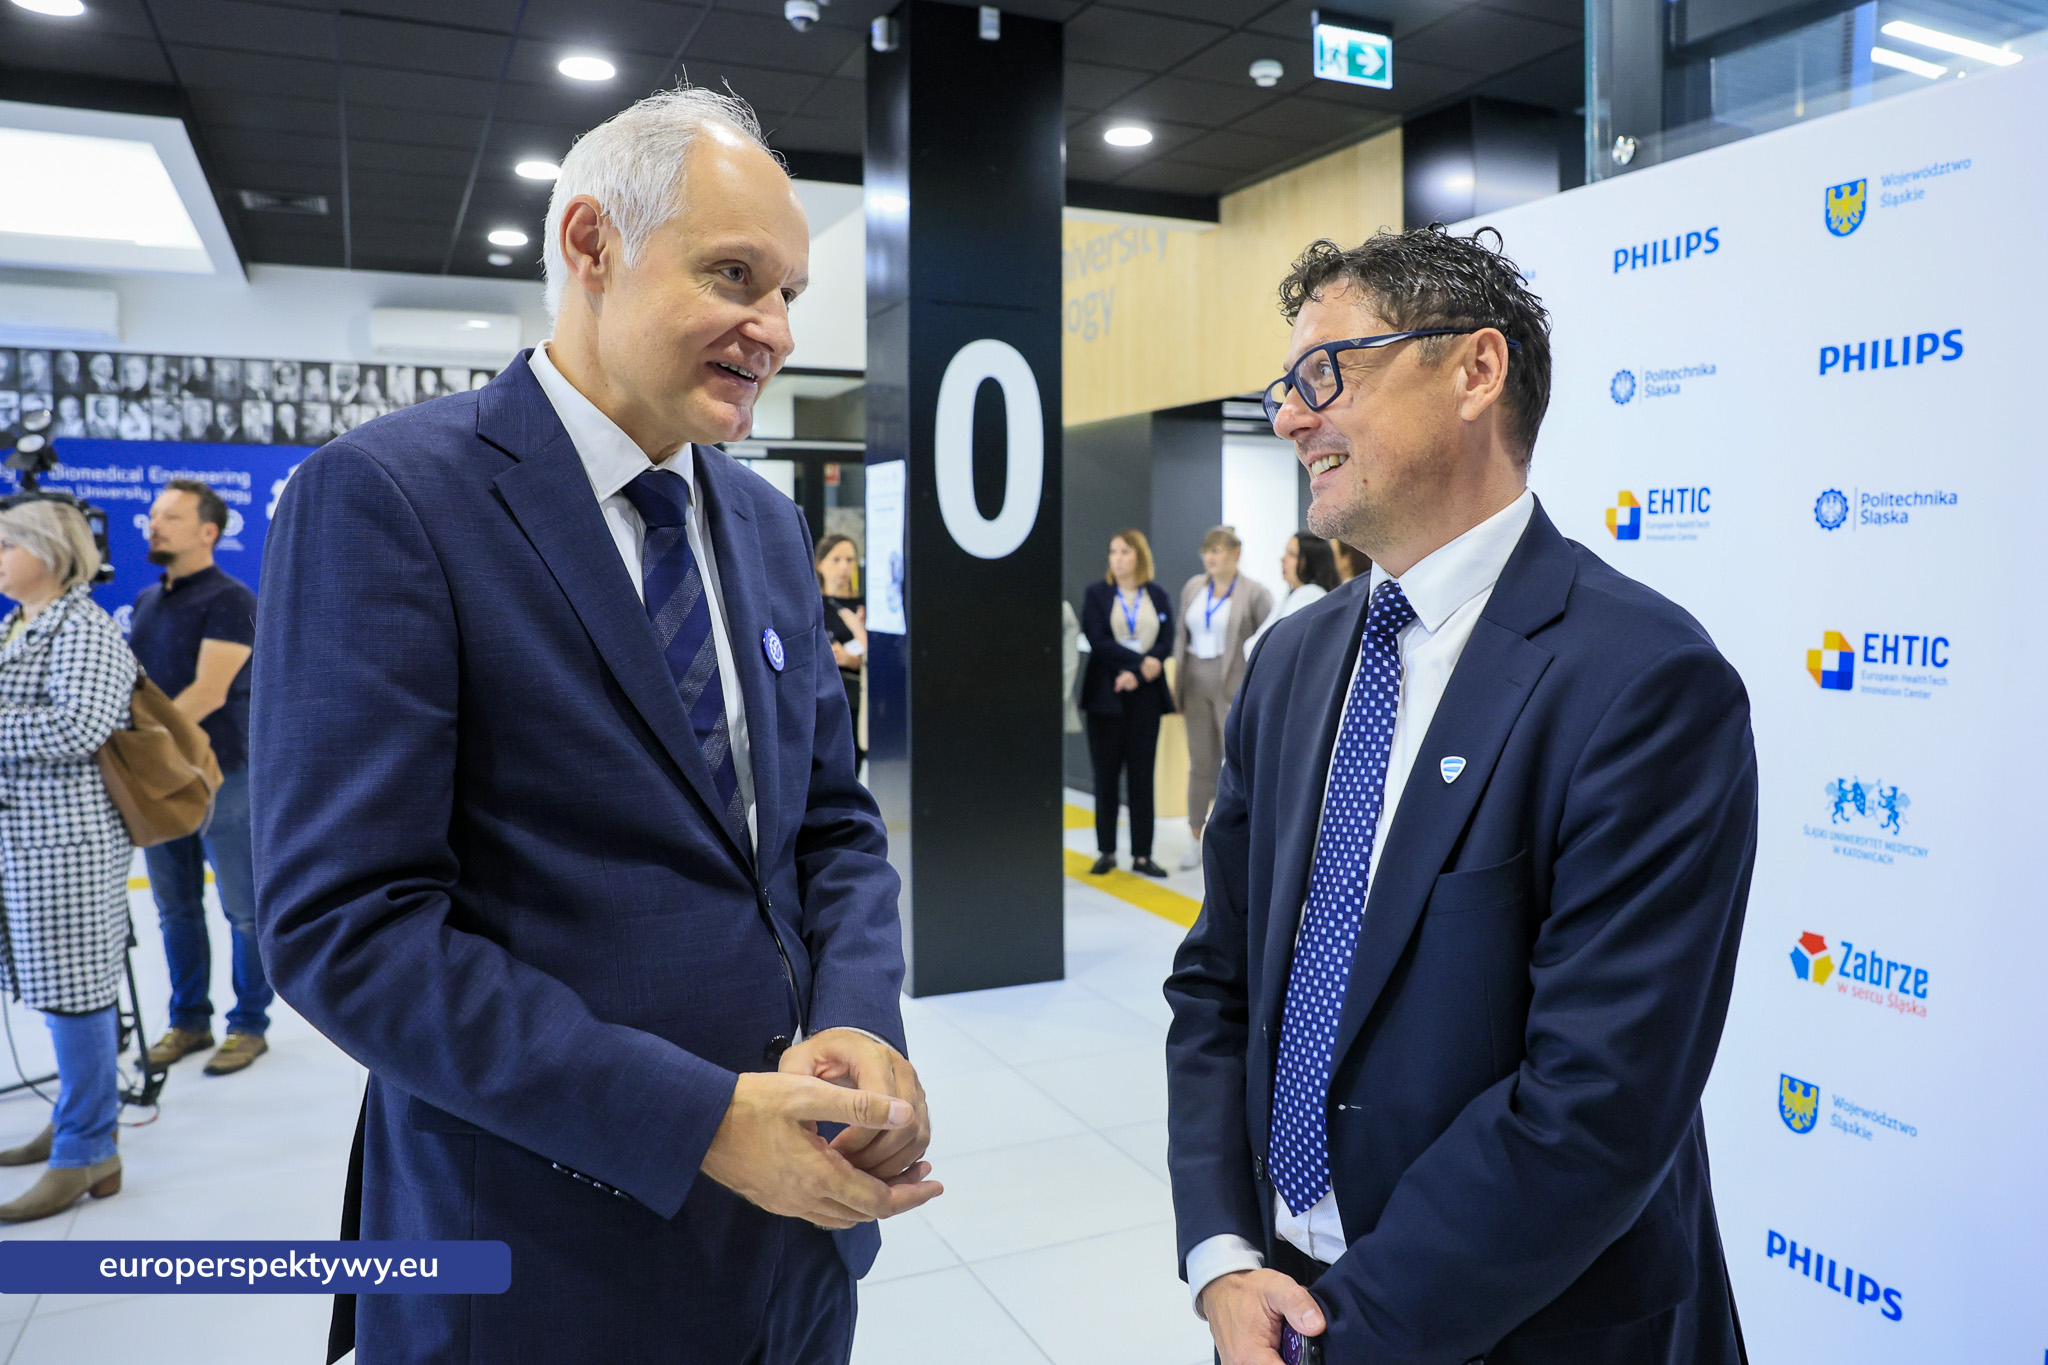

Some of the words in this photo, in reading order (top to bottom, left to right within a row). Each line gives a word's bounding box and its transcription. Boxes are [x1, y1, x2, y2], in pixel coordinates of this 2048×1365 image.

[1881, 158, 1972, 187] Województwo
[1613, 226, 1720, 274] PHILIPS
[1819, 328, 1964, 376] PHILIPS
[1644, 363, 1717, 383] Politechnika
[934, 338, 1044, 559] 0
[49, 463, 144, 483] Biomedical
[147, 465, 252, 490] Engineering
[1648, 486, 1711, 514] EHTIC
[1861, 490, 1958, 507] Politechnika
[1860, 508, 1909, 527] Śląska
[1863, 632, 1950, 668] EHTIC
[1839, 940, 1928, 1000] Zabrze
[1837, 982, 1848, 994] w
[1852, 985, 1884, 1005] sercu
[1829, 1112, 1873, 1141] Śląskie
[1831, 1093, 1918, 1138] Województwo
[1766, 1229, 1904, 1322] PHILIPS
